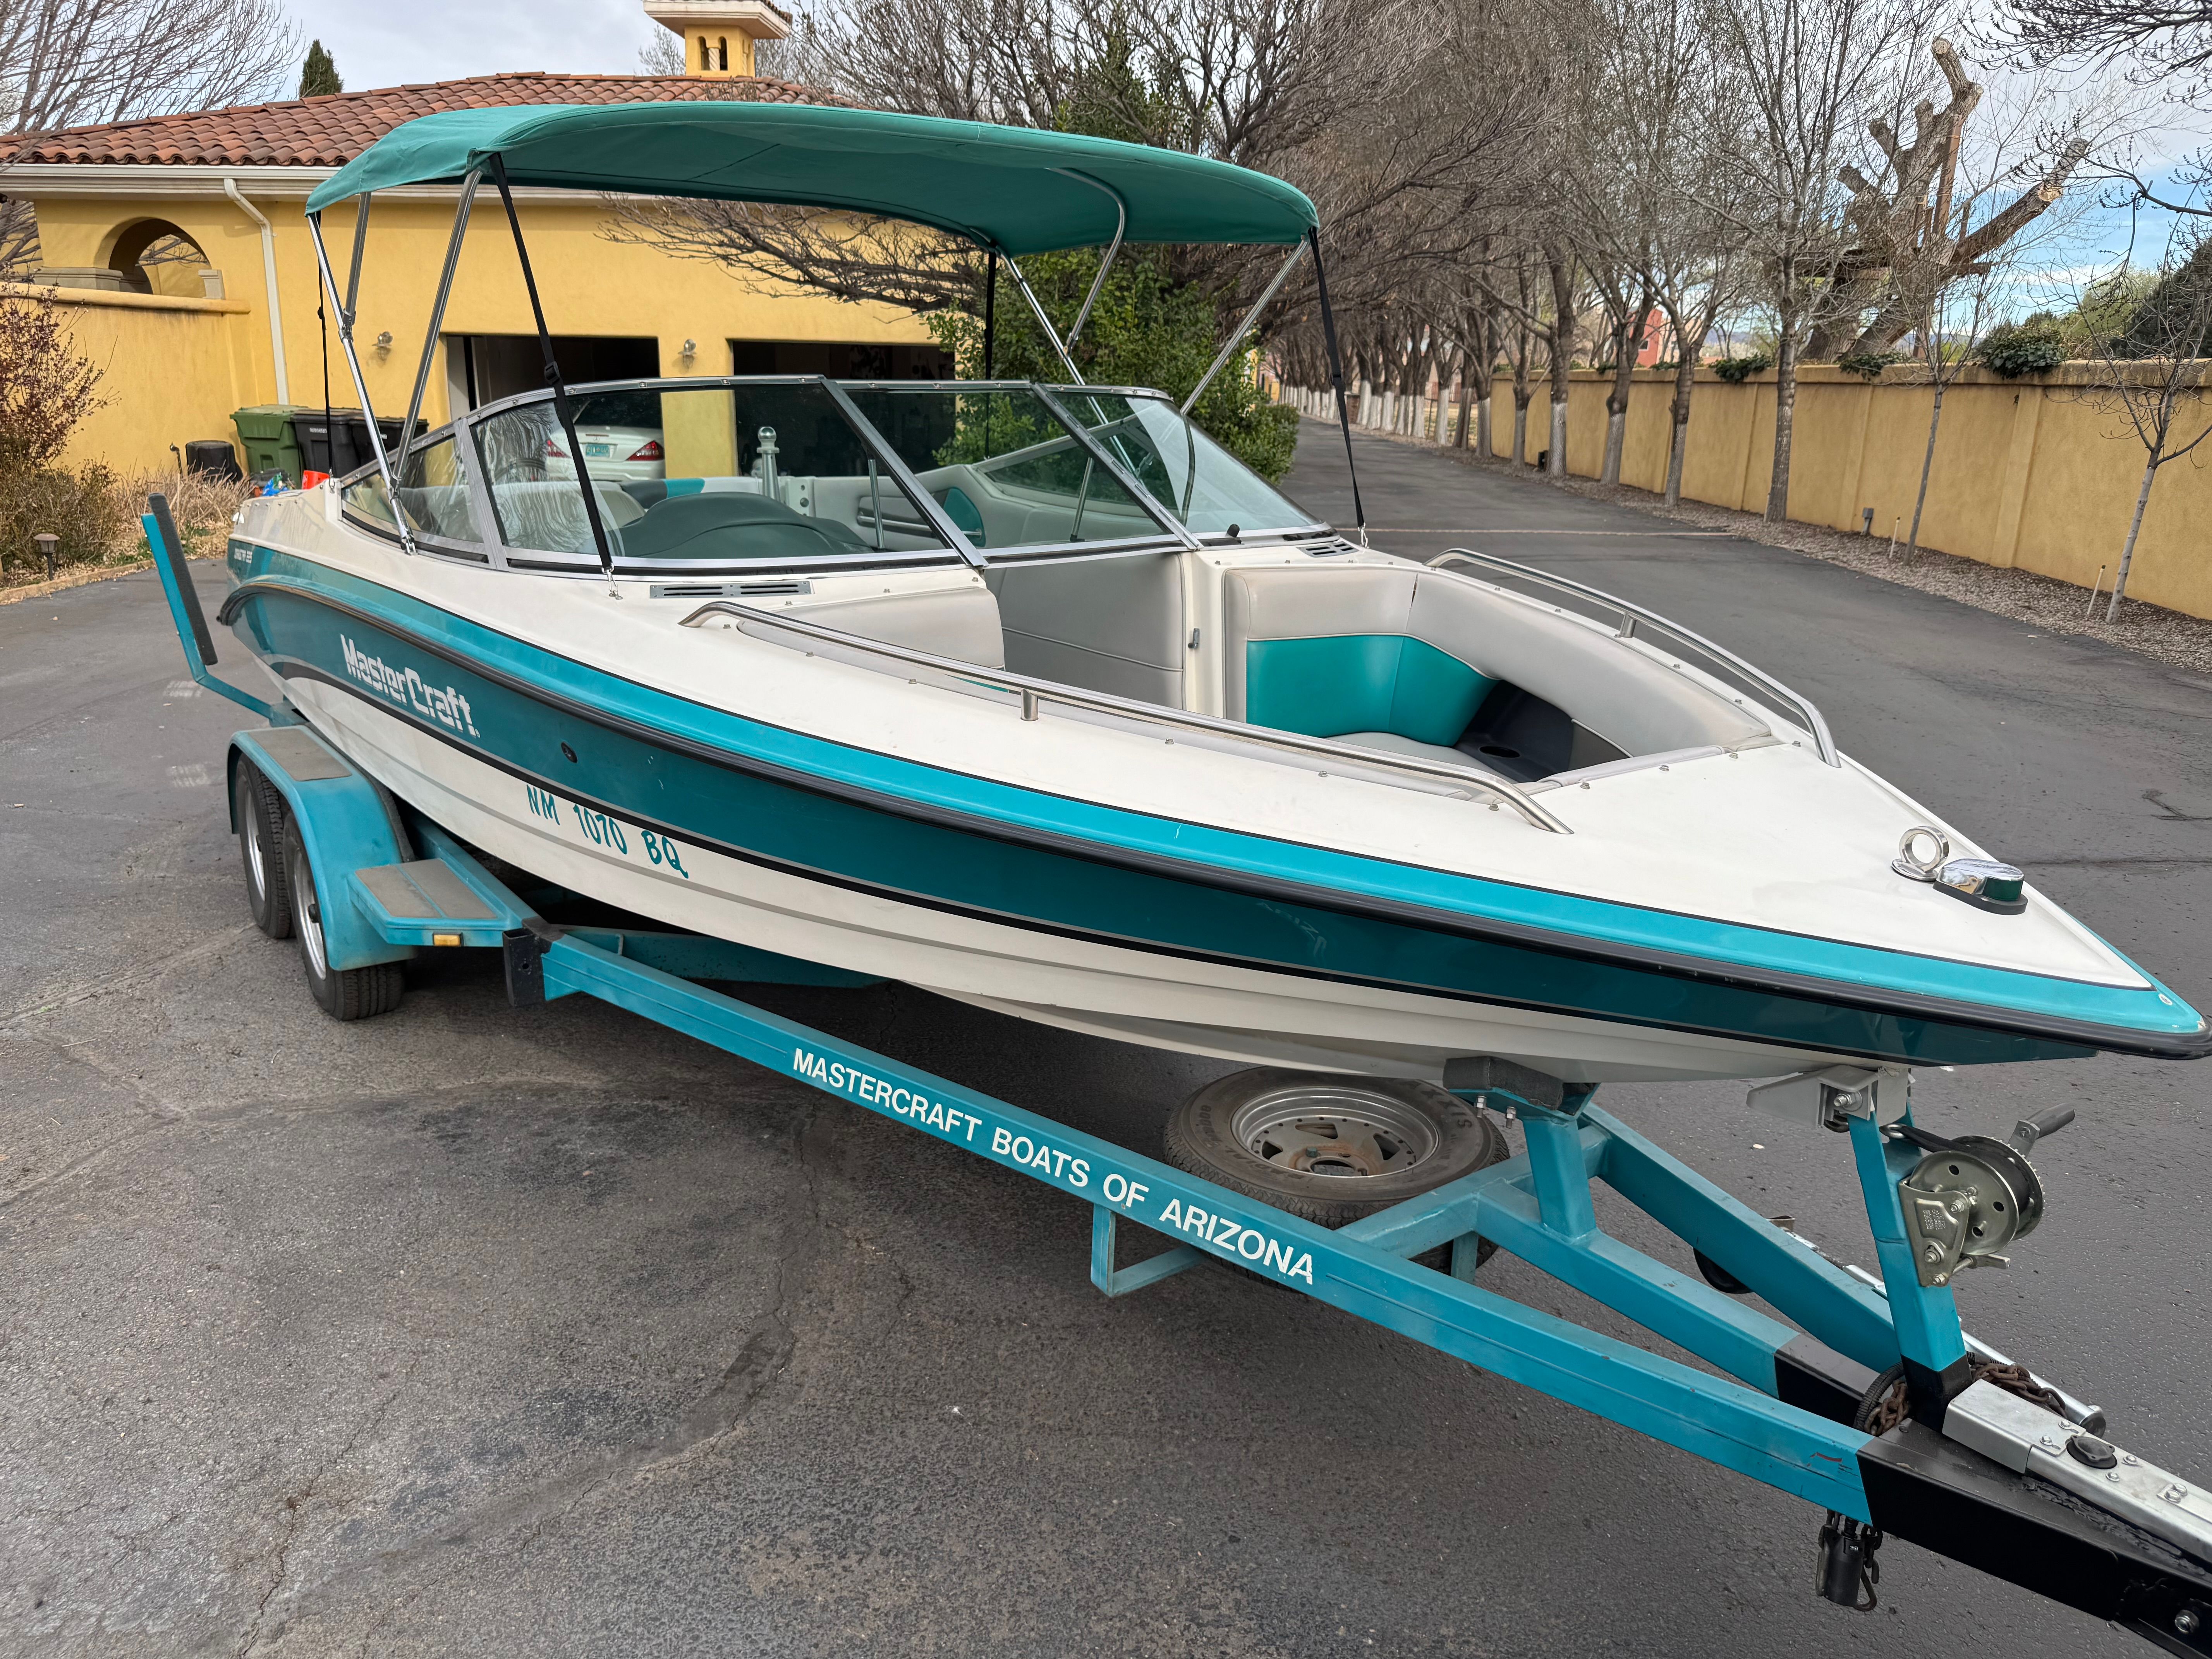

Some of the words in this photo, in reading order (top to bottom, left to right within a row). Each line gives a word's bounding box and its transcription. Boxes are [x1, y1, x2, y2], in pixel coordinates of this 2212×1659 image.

[340, 634, 477, 738] MasterCraft
[526, 784, 560, 826] NM
[573, 804, 628, 855] 1070
[641, 830, 689, 879] BQ
[793, 1048, 982, 1141] MASTERCRAFT
[991, 1127, 1090, 1187] BOATS
[1103, 1173, 1149, 1208] OF
[1159, 1198, 1313, 1286] ARIZONA
